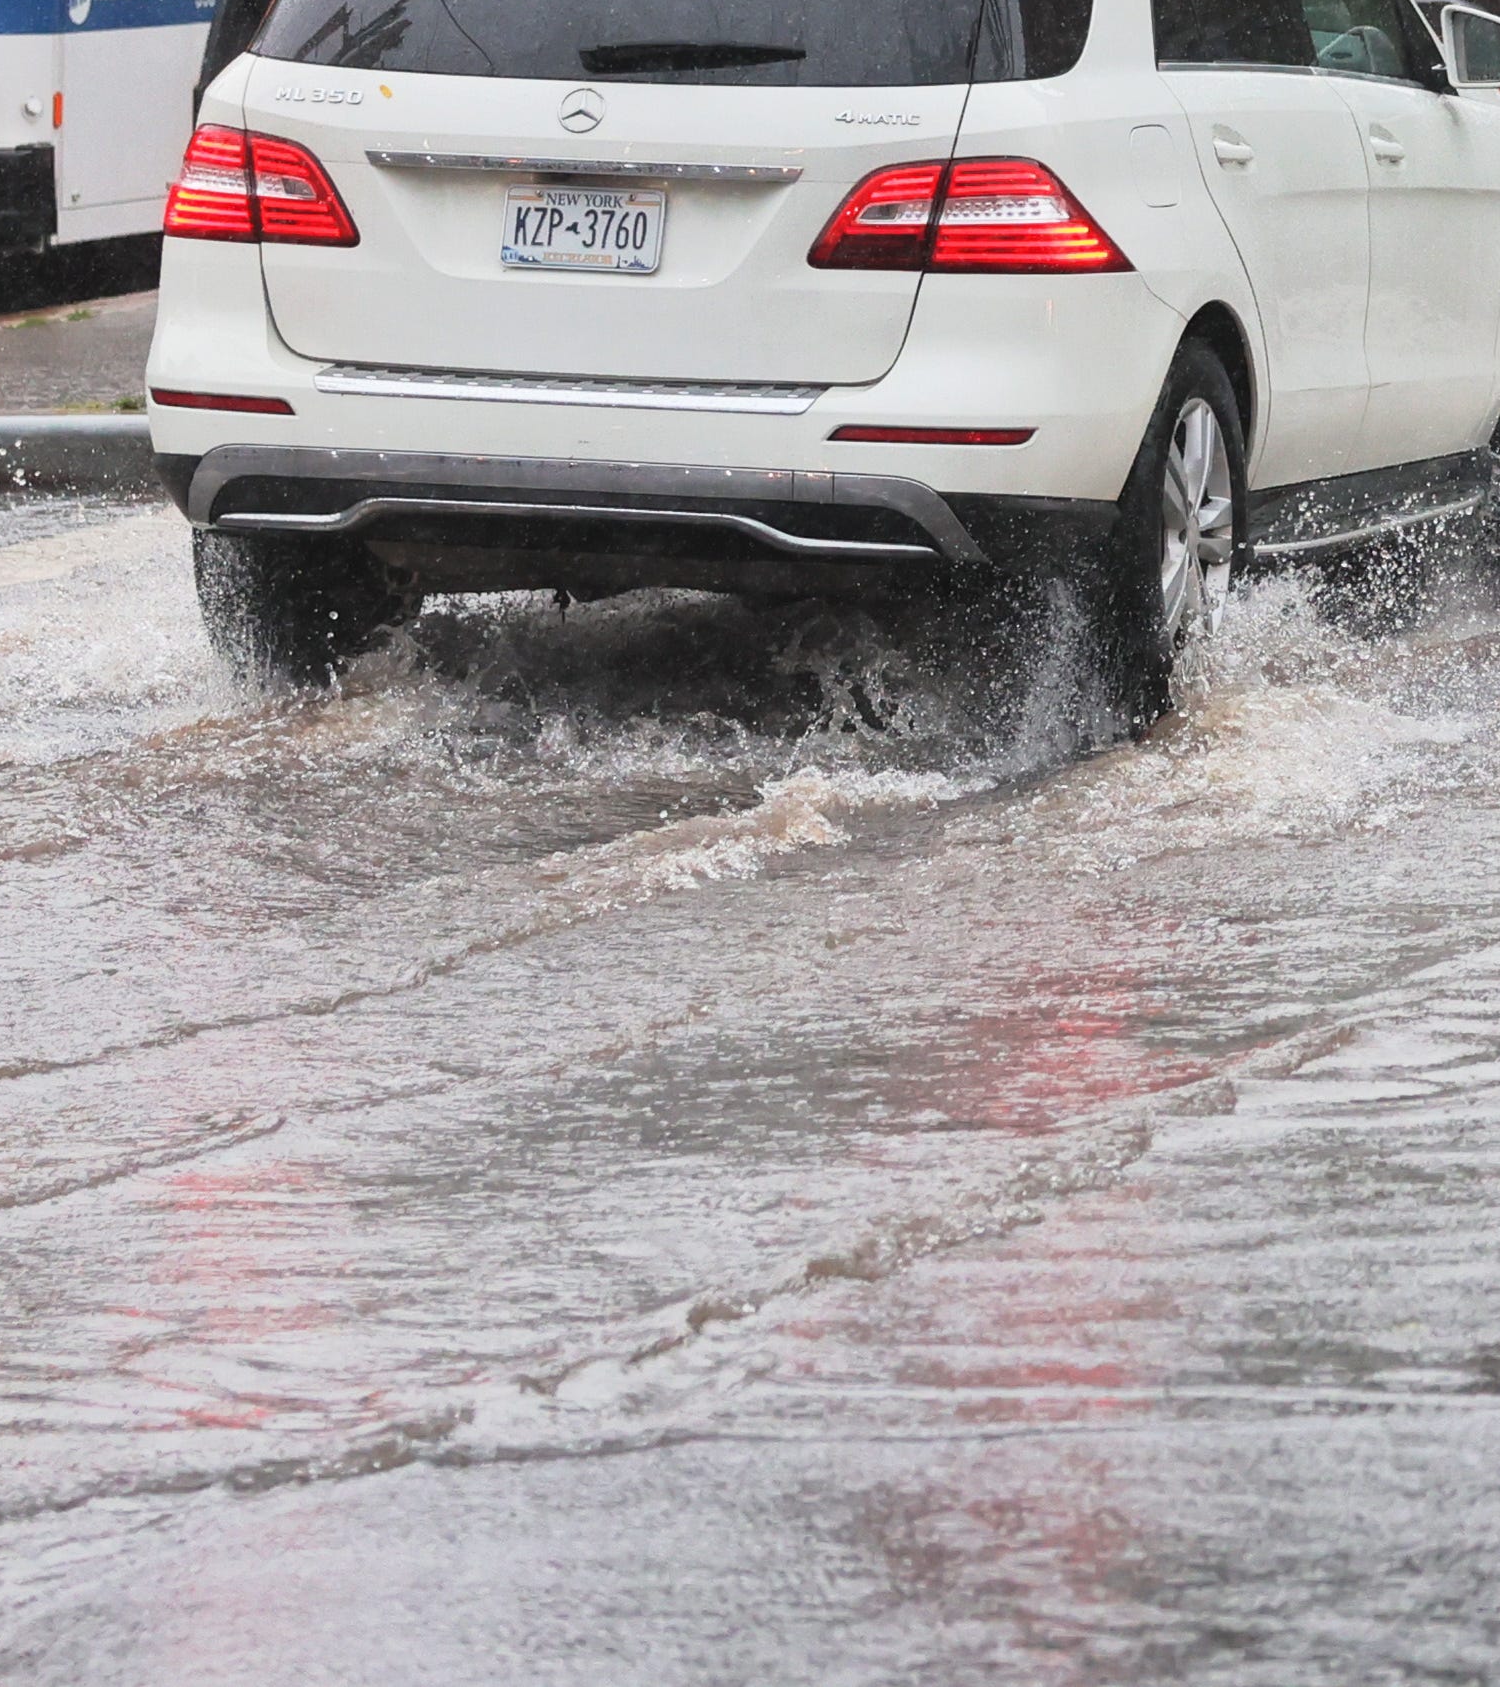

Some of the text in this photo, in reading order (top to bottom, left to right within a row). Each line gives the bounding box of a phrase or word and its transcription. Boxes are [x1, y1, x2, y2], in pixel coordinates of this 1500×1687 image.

[275, 86, 364, 105] ML 350
[546, 193, 623, 209] NEW YORK
